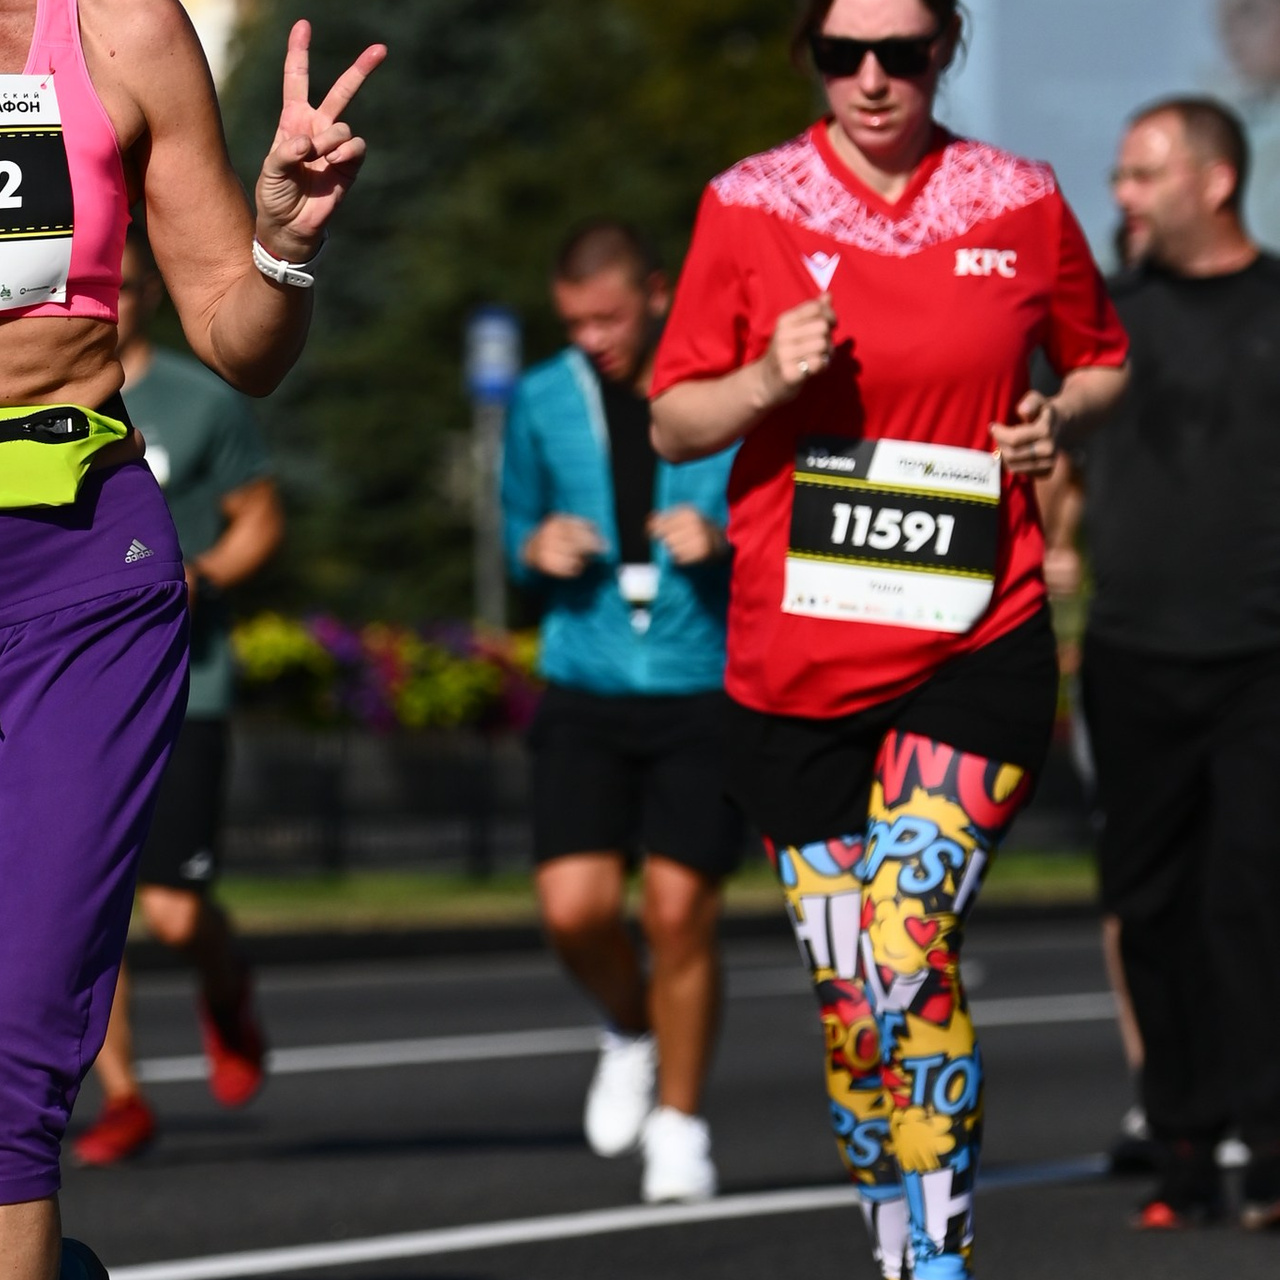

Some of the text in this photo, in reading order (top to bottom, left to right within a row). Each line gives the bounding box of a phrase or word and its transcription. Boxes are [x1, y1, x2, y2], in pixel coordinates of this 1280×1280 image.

[954, 248, 1017, 279] KFC
[830, 502, 956, 556] 11591
[124, 549, 155, 564] adidas
